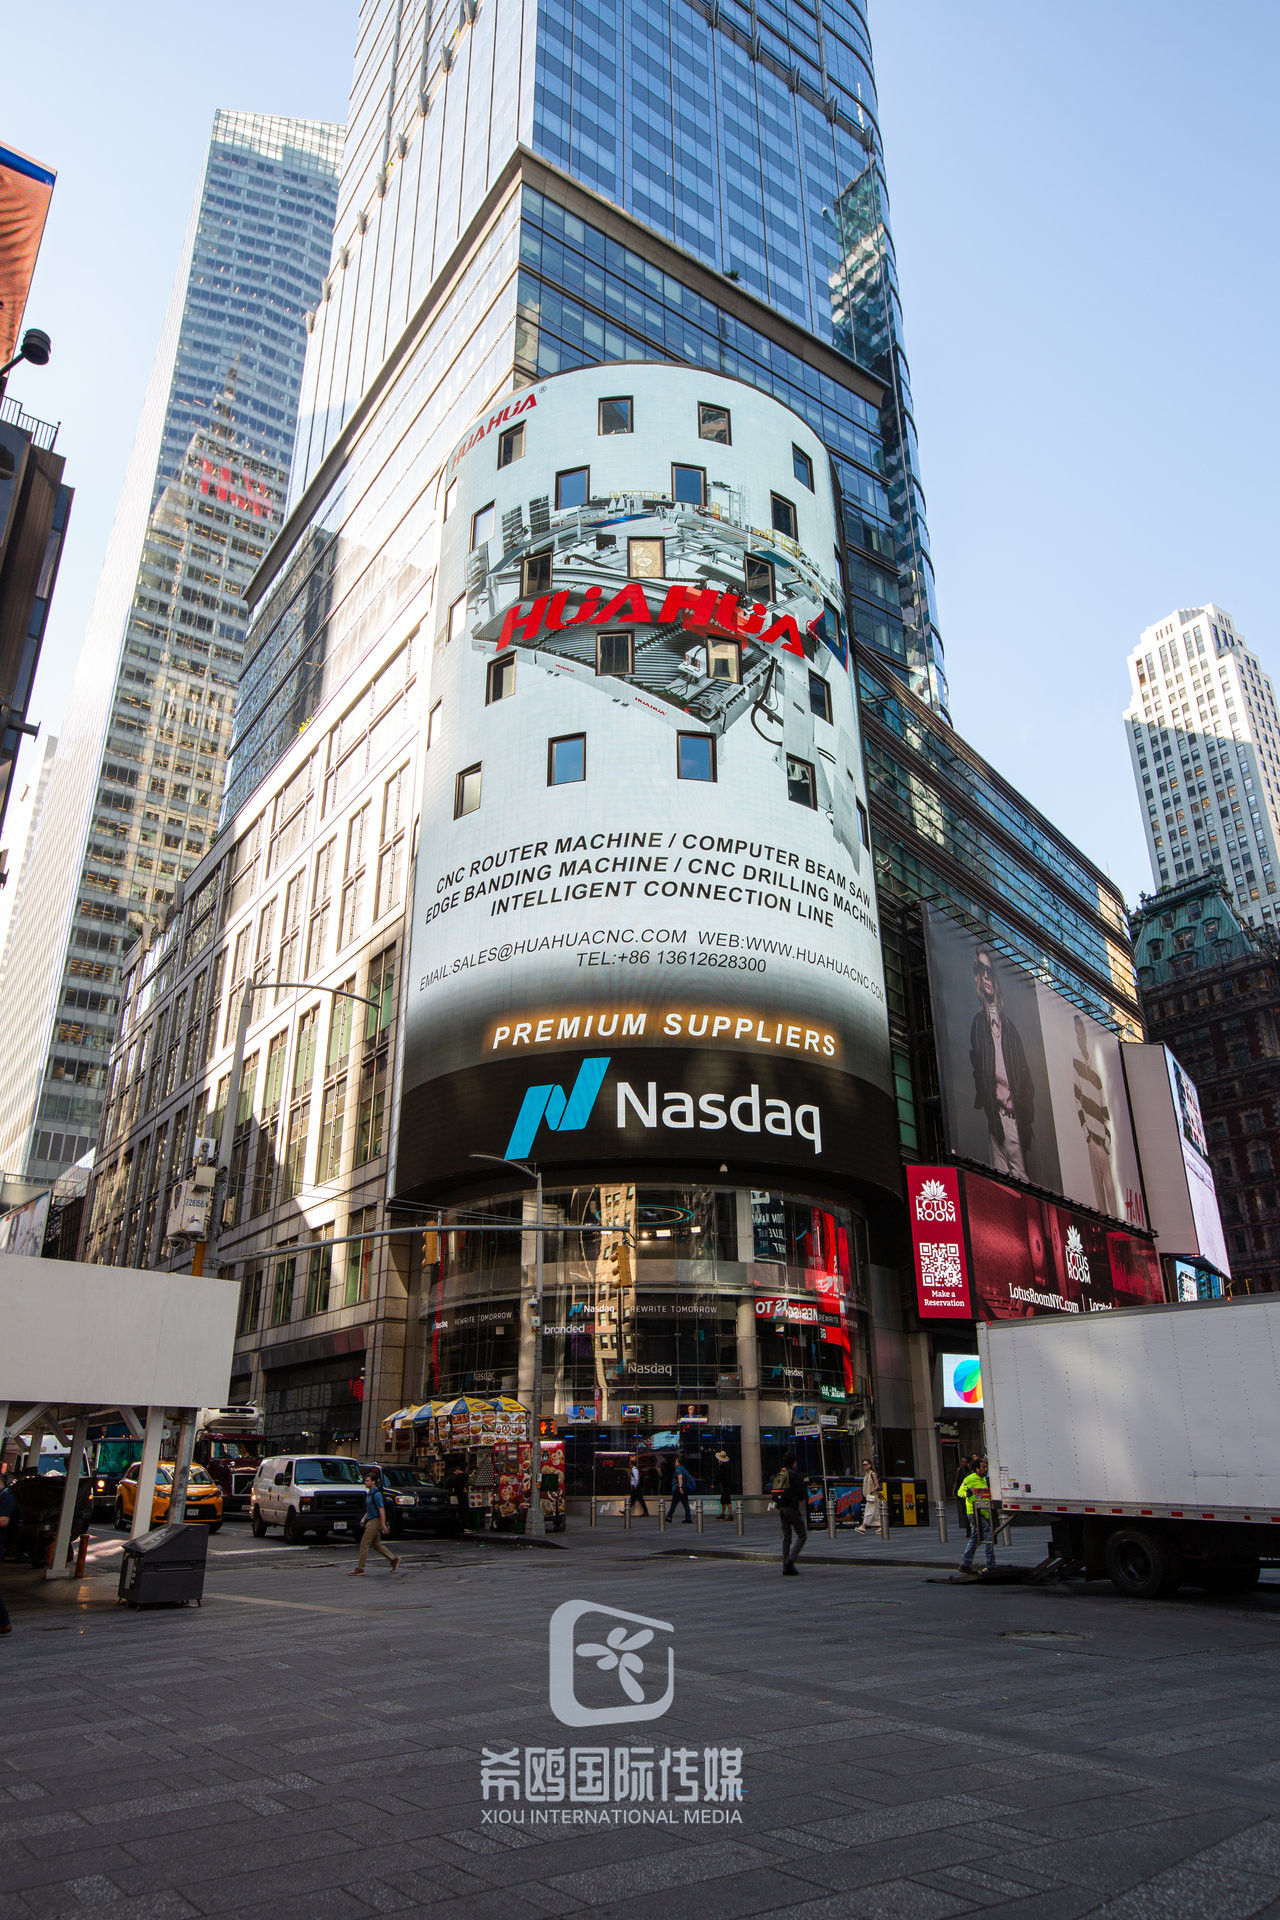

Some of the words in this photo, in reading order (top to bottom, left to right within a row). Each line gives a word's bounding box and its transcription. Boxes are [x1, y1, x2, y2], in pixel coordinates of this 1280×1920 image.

[452, 393, 537, 472] HUAHUA
[495, 584, 805, 660] HUAHUA
[436, 867, 465, 894] CNC
[469, 841, 548, 878] ROUTER
[555, 832, 663, 854] MACHINE
[668, 833, 677, 848] /
[682, 834, 799, 869] COMPUTER
[805, 858, 846, 890] BEAM
[849, 881, 871, 909] SAW
[425, 891, 460, 924] EDGE
[464, 864, 552, 903] BANDING
[558, 856, 668, 877] MACHINE
[674, 857, 682, 872] /
[688, 858, 736, 877] CNC
[743, 865, 829, 902] DRILLING
[833, 893, 878, 939] MACHINE
[490, 881, 637, 916] INTELLIGENT
[644, 881, 791, 913] CONNECTION
[797, 901, 834, 928] LINE
[419, 929, 687, 991] EMAIL:SALES@HUAHUACNC.COM
[698, 931, 884, 1002] WEB:WWW.HUAHUACNC.COM
[576, 951, 650, 967] TEL:+86
[657, 951, 767, 972] 13612628300
[492, 1013, 647, 1050] PREMIUM
[663, 1013, 835, 1057] SUPPLIERS
[616, 1081, 823, 1155] Nasdaq
[915, 1199, 955, 1212] LOTUS
[917, 1209, 956, 1222] ROOM
[1065, 1248, 1089, 1271] LOTUS
[1067, 1266, 1091, 1284] ROOM
[584, 1304, 615, 1315] Nasdaq
[671, 1305, 718, 1313] TOMORROW
[924, 1299, 965, 1307] Reservation
[1009, 1283, 1079, 1313] LotusRoomNYC.com
[476, 1311, 513, 1322] TOMORROW
[628, 1363, 672, 1376] Nasdaq
